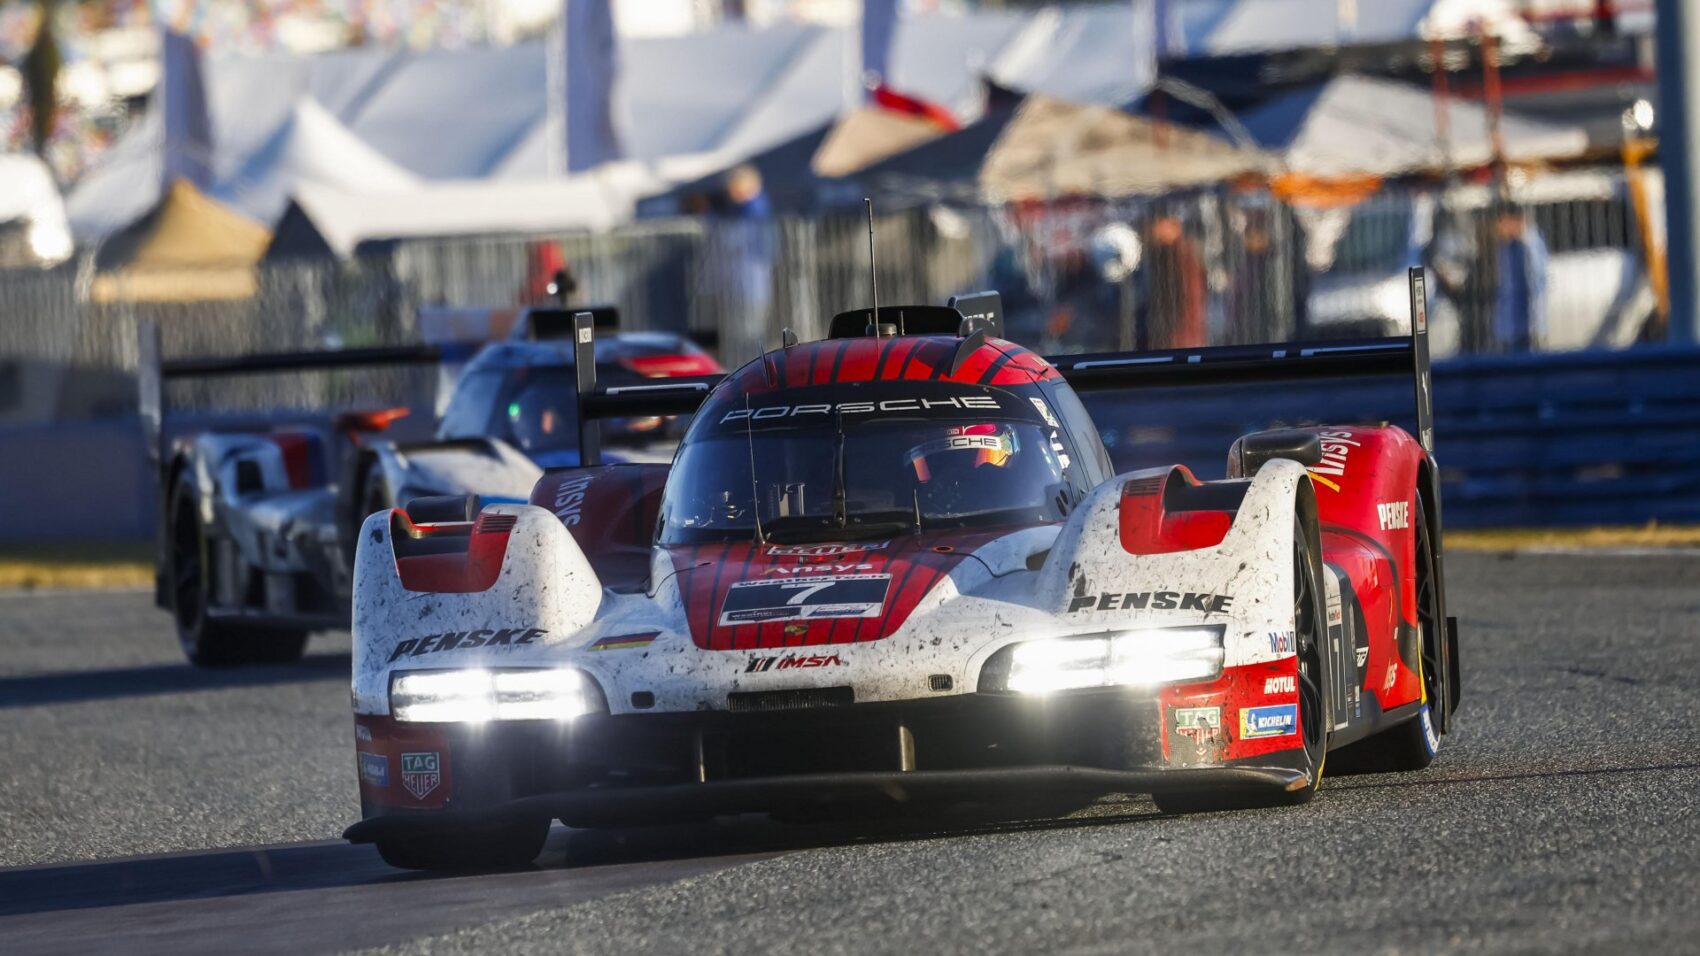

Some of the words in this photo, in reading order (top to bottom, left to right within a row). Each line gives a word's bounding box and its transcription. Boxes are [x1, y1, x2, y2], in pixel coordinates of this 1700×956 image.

[719, 396, 1001, 425] PORSCHE
[1377, 501, 1409, 531] PENSKE
[760, 563, 873, 575] Ansys
[780, 581, 836, 606] 7
[1067, 591, 1234, 613] PENSKE
[386, 628, 549, 664] PENSKE
[775, 655, 842, 670] IMSA
[1264, 676, 1296, 695] MOTUL
[404, 756, 436, 770] TAG
[404, 774, 438, 796] HEUER
